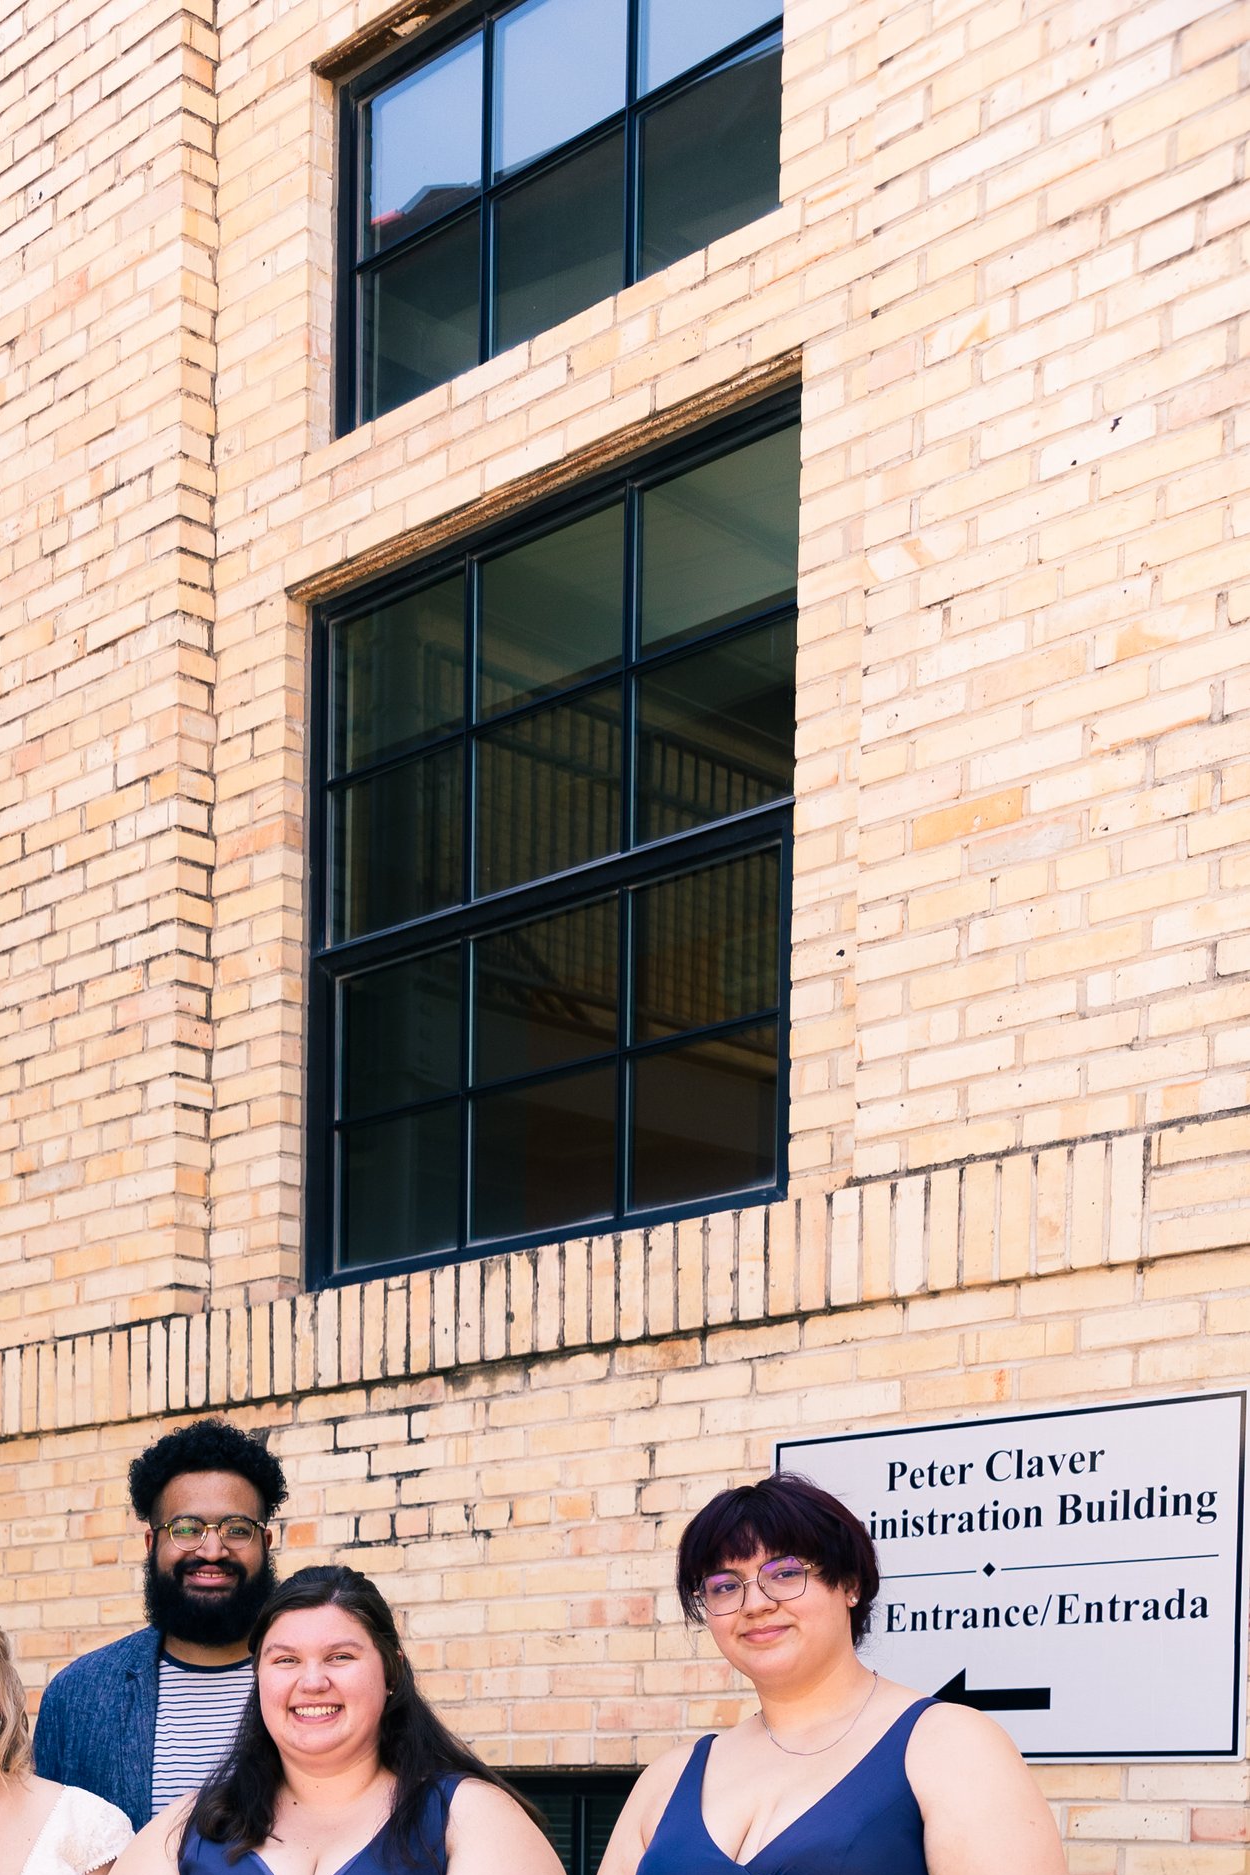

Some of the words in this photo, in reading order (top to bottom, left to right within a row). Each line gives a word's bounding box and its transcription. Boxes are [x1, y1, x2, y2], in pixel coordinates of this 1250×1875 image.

[885, 1460, 974, 1492] Peter
[985, 1447, 1106, 1482] Claver
[862, 1499, 1043, 1541] inistration
[1057, 1485, 1219, 1526] Building
[885, 1587, 1210, 1633] Entrance/Entrada
